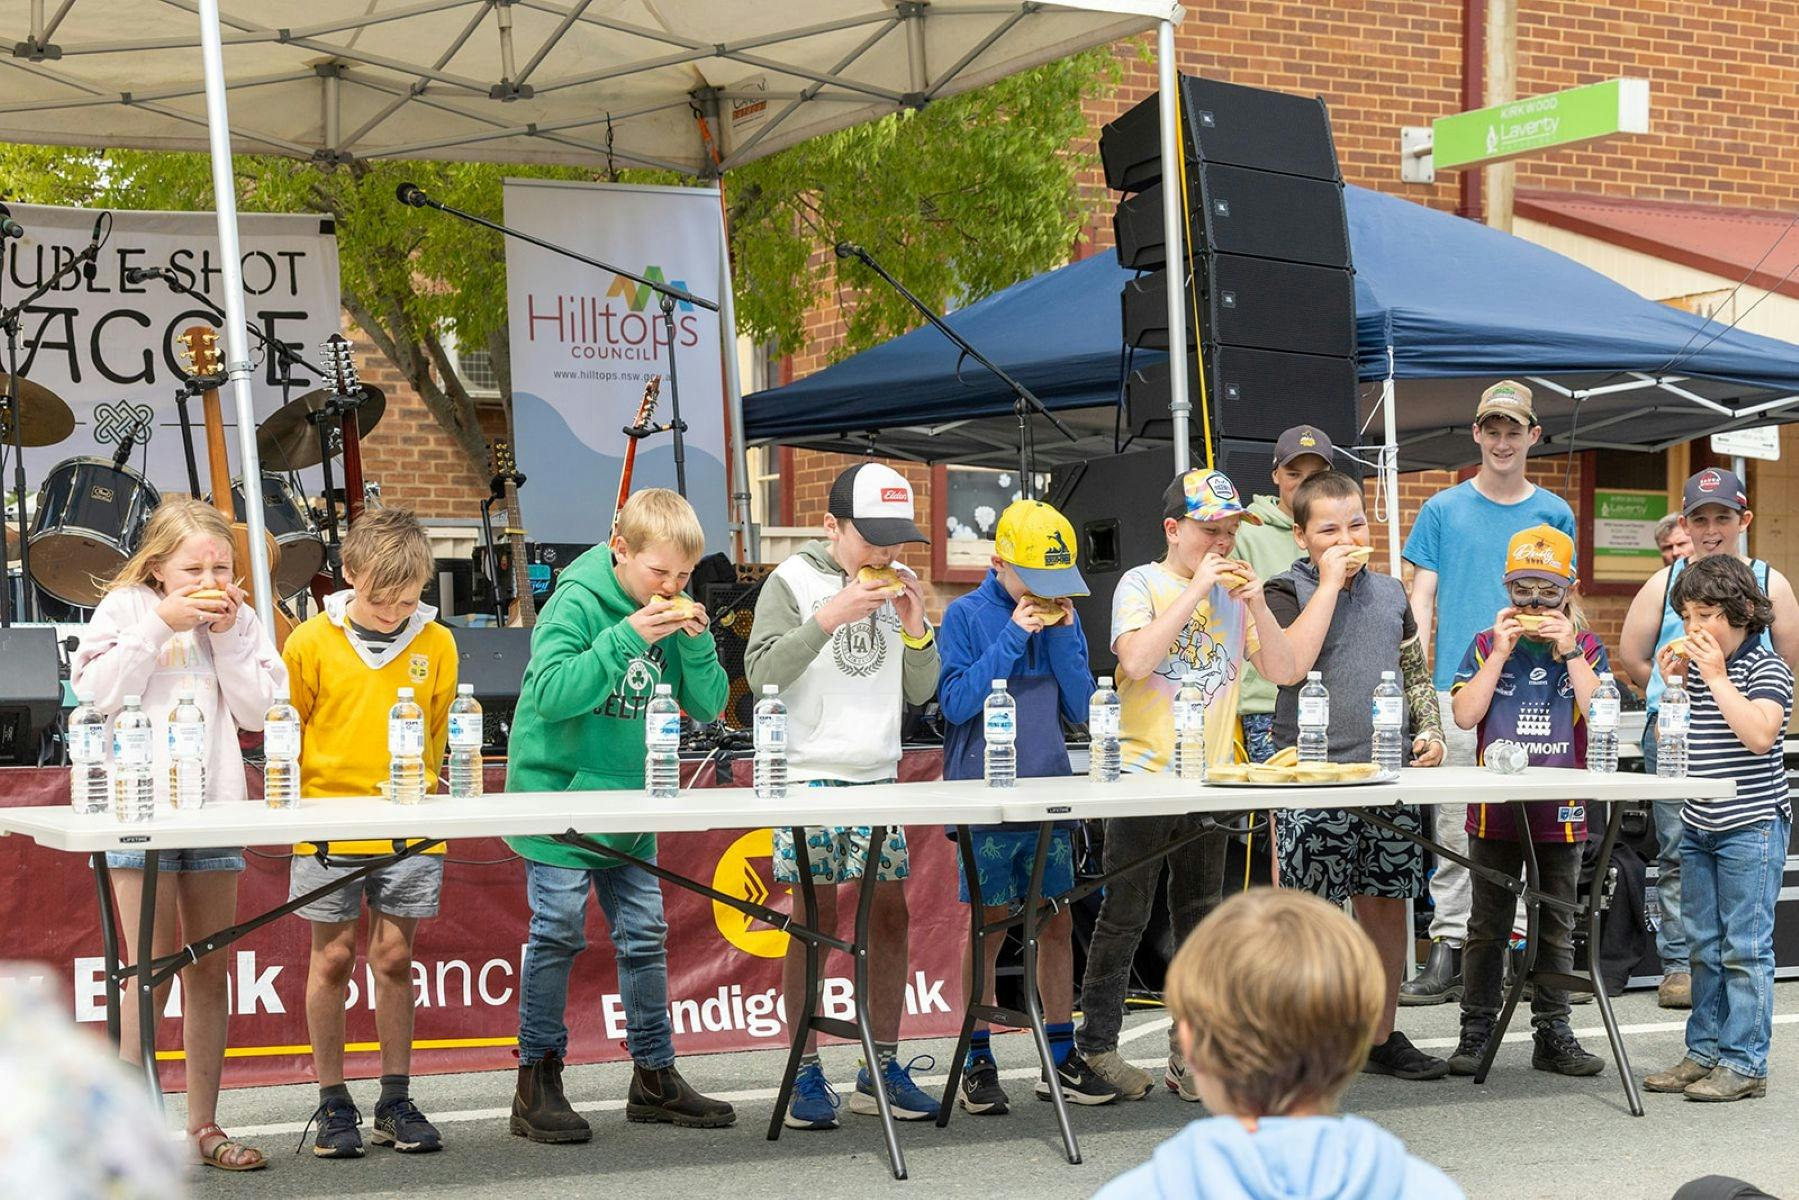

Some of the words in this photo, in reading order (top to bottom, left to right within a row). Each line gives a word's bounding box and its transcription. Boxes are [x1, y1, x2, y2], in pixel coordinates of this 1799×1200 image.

[1500, 116, 1560, 140] Laverty
[528, 294, 698, 360] Hilltops
[571, 346, 650, 360] COUNCIL
[852, 635, 868, 653] LA
[593, 691, 655, 720] ELTI
[74, 950, 286, 1022] Bk
[600, 985, 788, 1039] Bndig
[822, 970, 952, 1022] Bk
